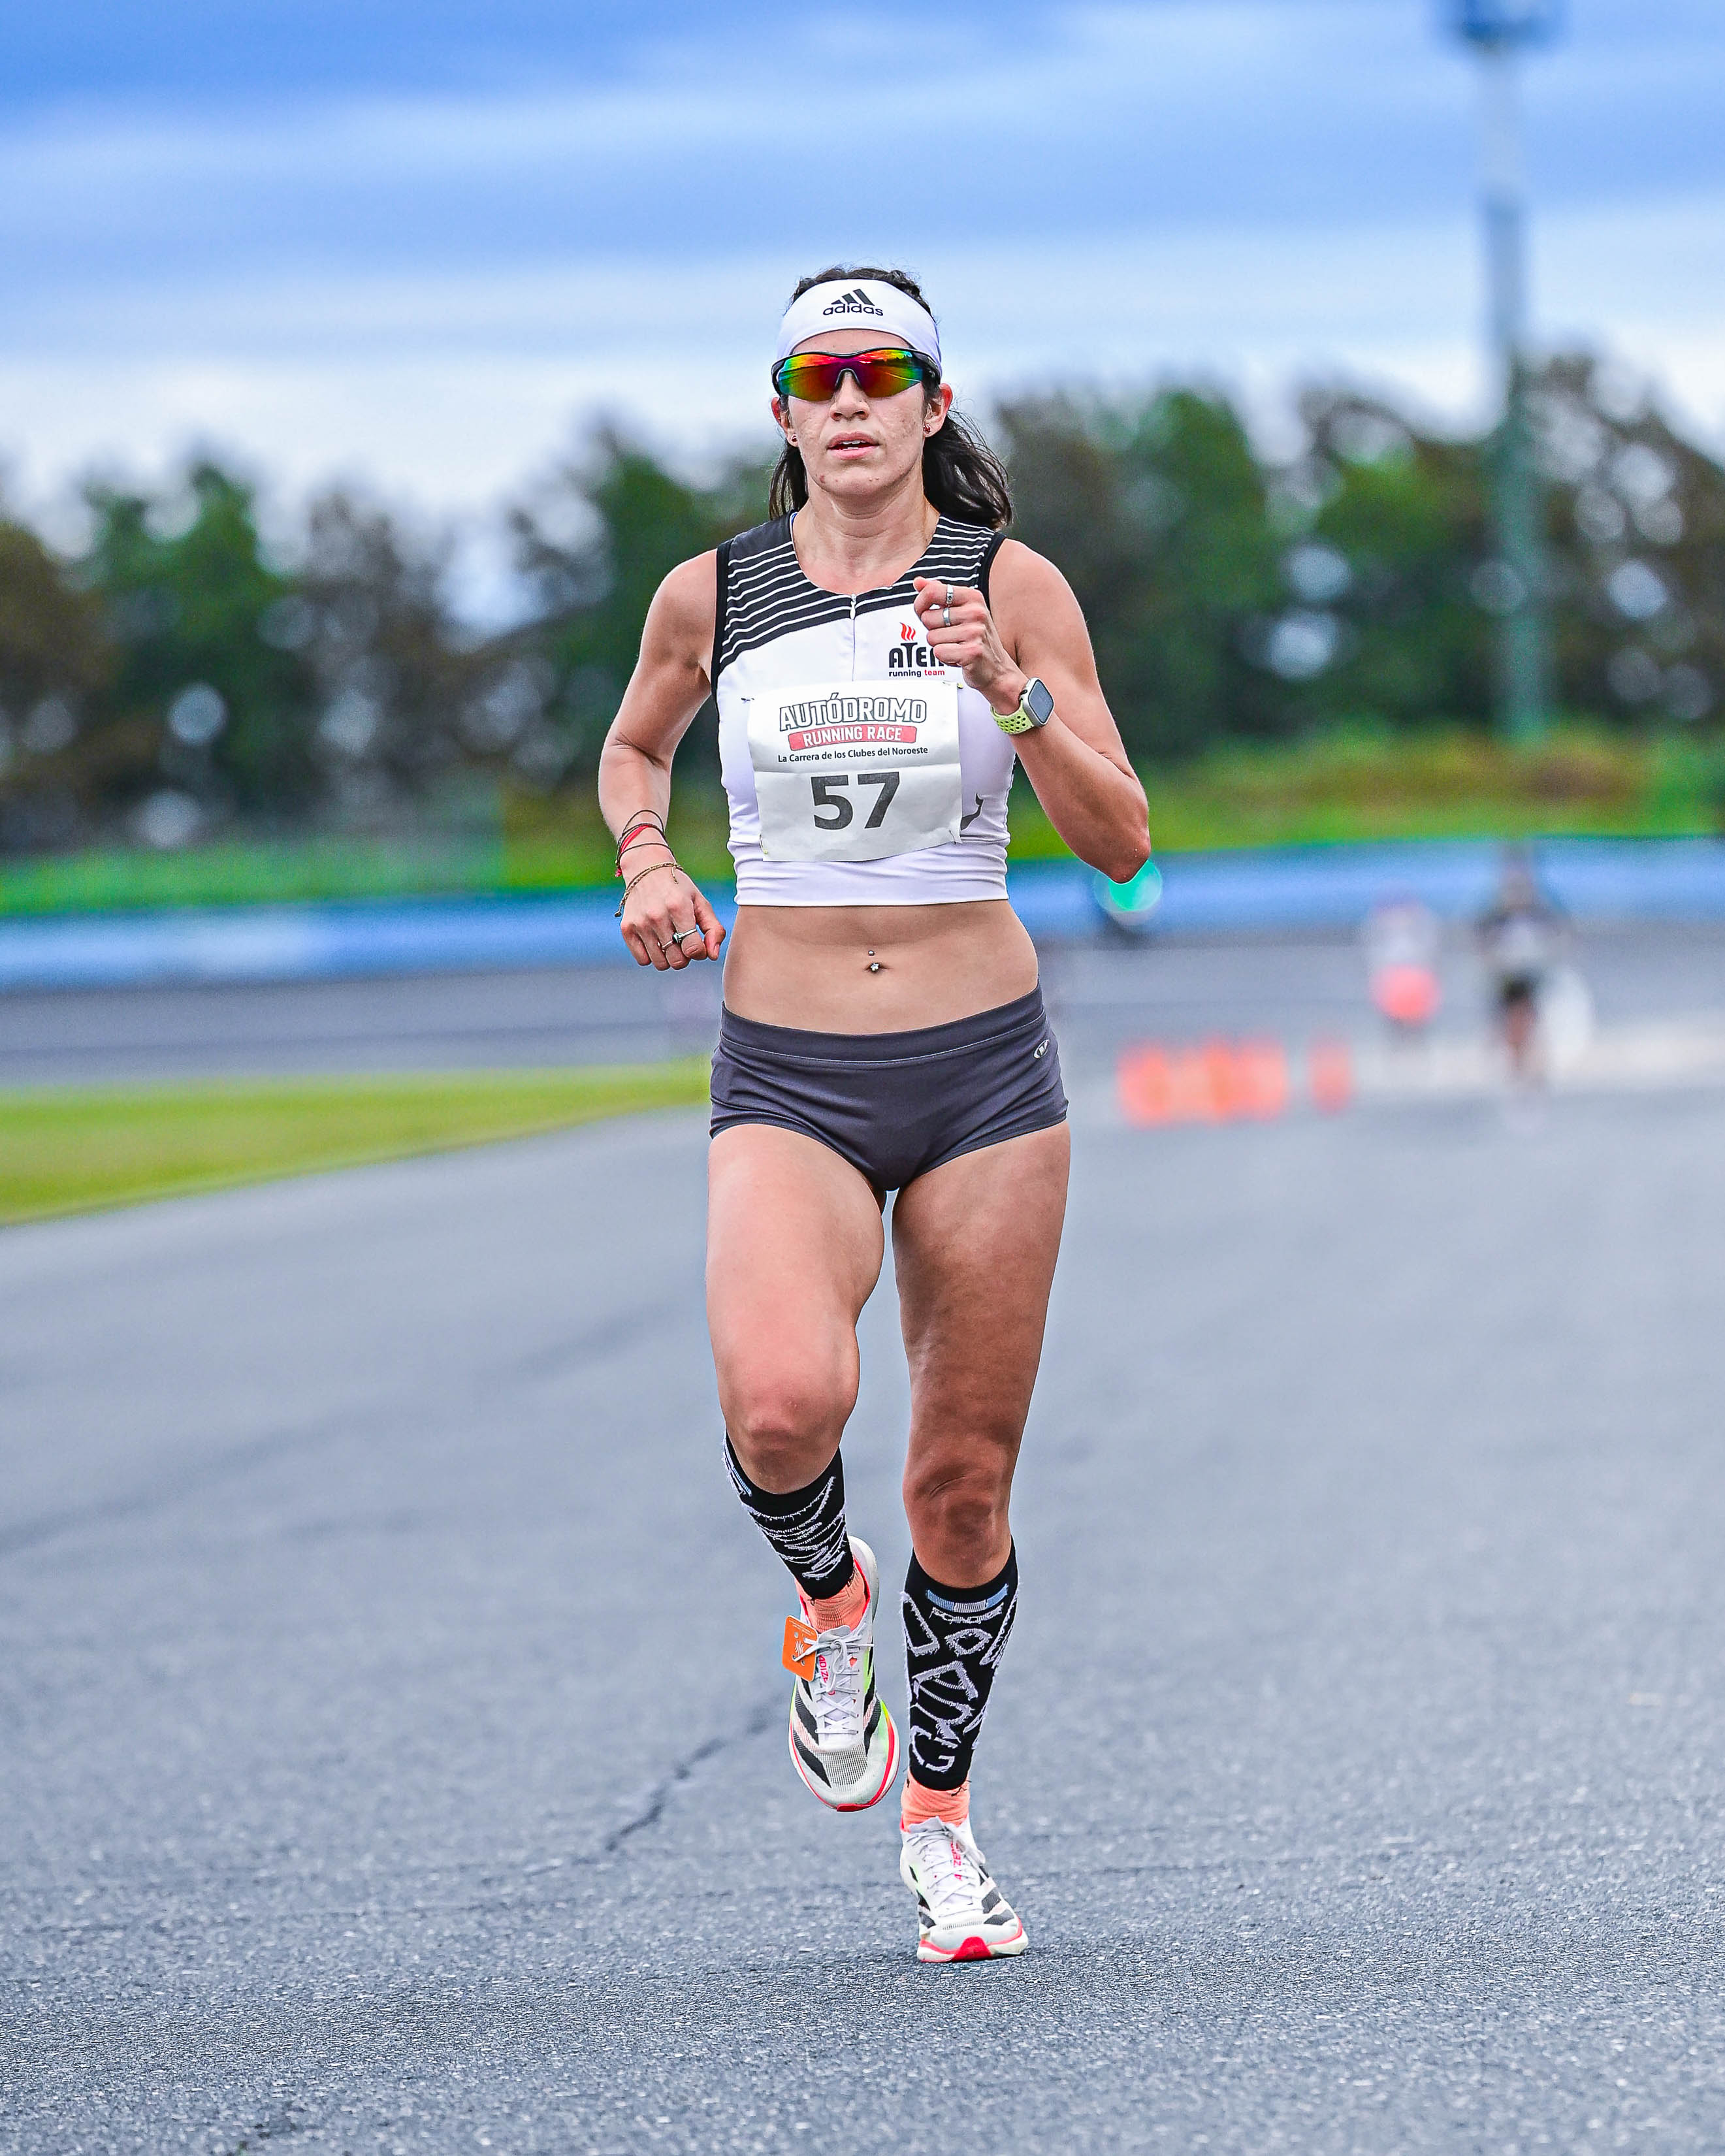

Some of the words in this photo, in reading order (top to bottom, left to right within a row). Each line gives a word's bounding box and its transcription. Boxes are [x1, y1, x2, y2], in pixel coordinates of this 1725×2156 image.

[823, 304, 884, 316] adidas
[779, 692, 927, 732] AUTÓDROMO
[802, 726, 863, 747] RUNNING
[867, 726, 903, 741] RACE
[777, 754, 787, 763] La
[789, 752, 820, 762] Carrera
[821, 750, 831, 760] de
[834, 750, 846, 759] los
[848, 748, 876, 758] Clubes
[877, 747, 890, 756] del
[892, 747, 928, 755] Noroeste
[811, 771, 900, 830] 57
